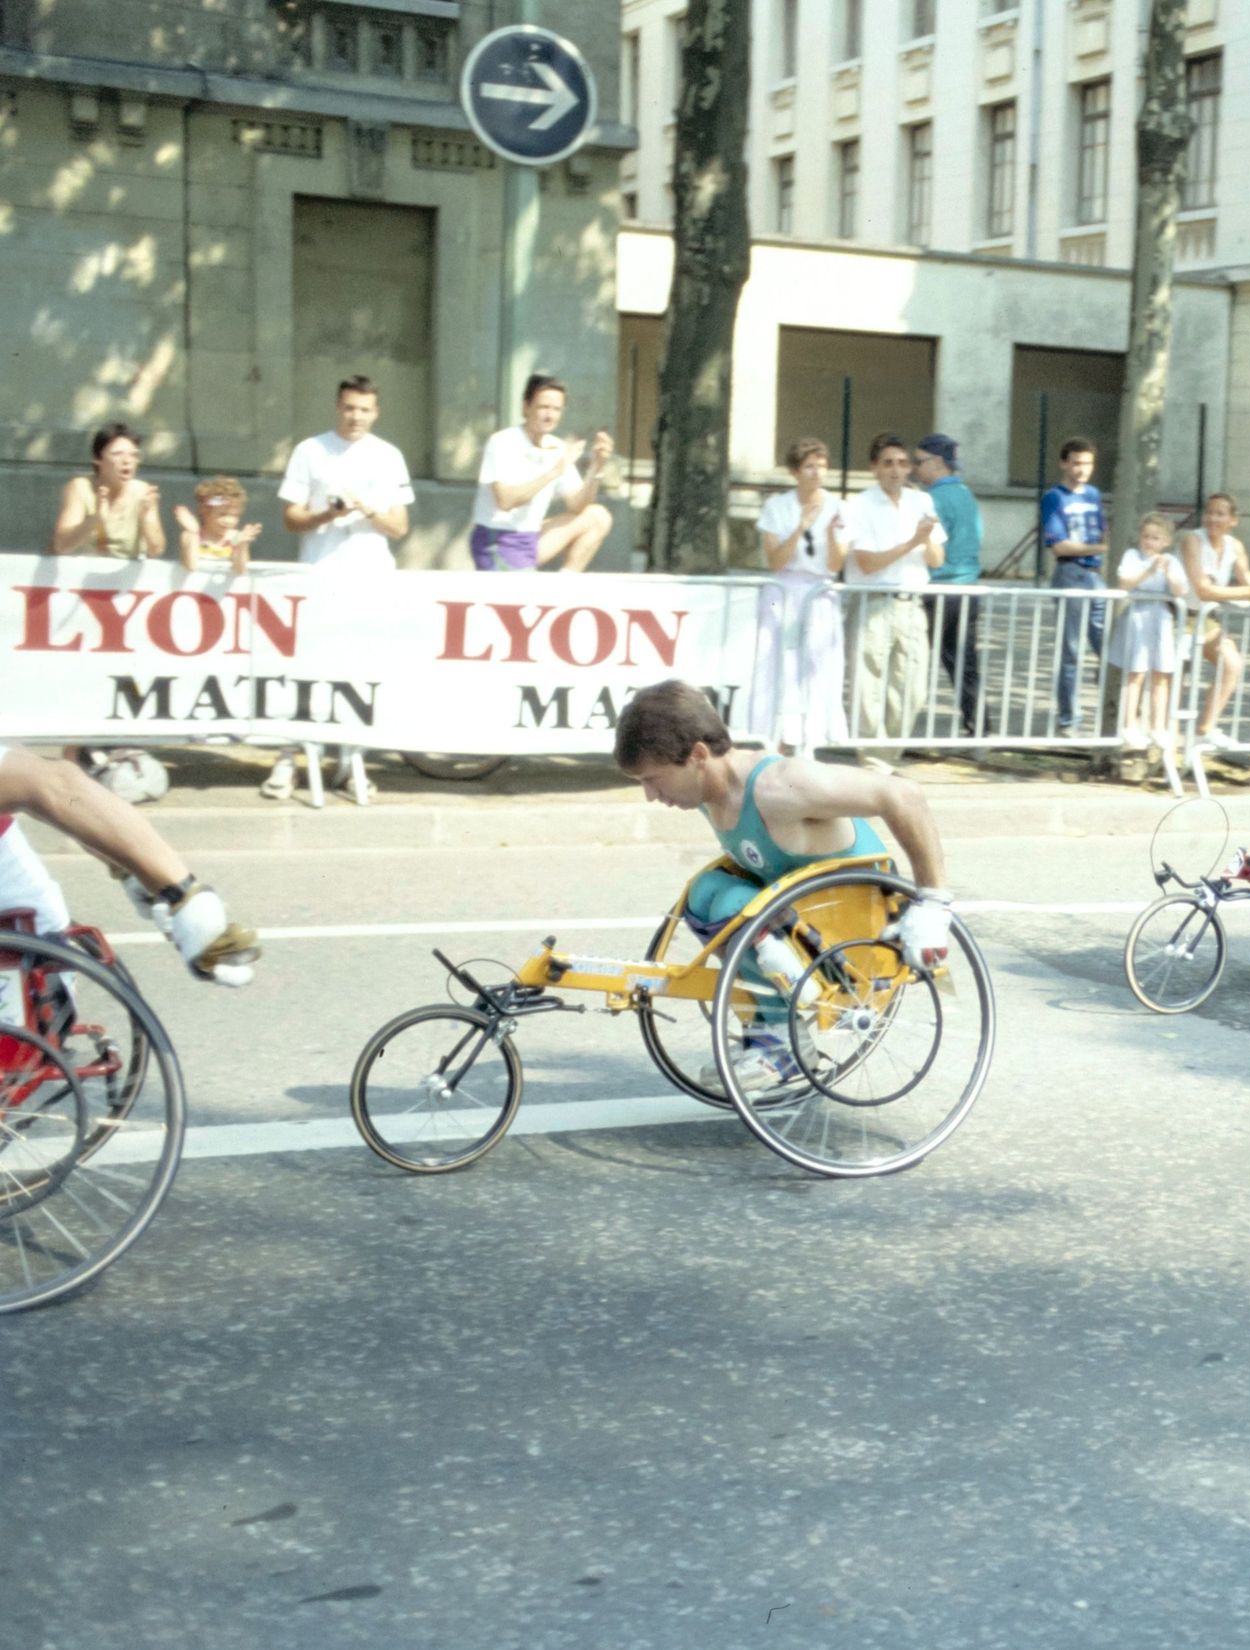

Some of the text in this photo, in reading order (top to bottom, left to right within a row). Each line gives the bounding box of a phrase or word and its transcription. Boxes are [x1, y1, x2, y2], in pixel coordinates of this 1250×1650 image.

[11, 585, 307, 657] LYON
[435, 600, 689, 667] LYON
[104, 674, 381, 726] MATIN
[511, 685, 741, 730] MAN
